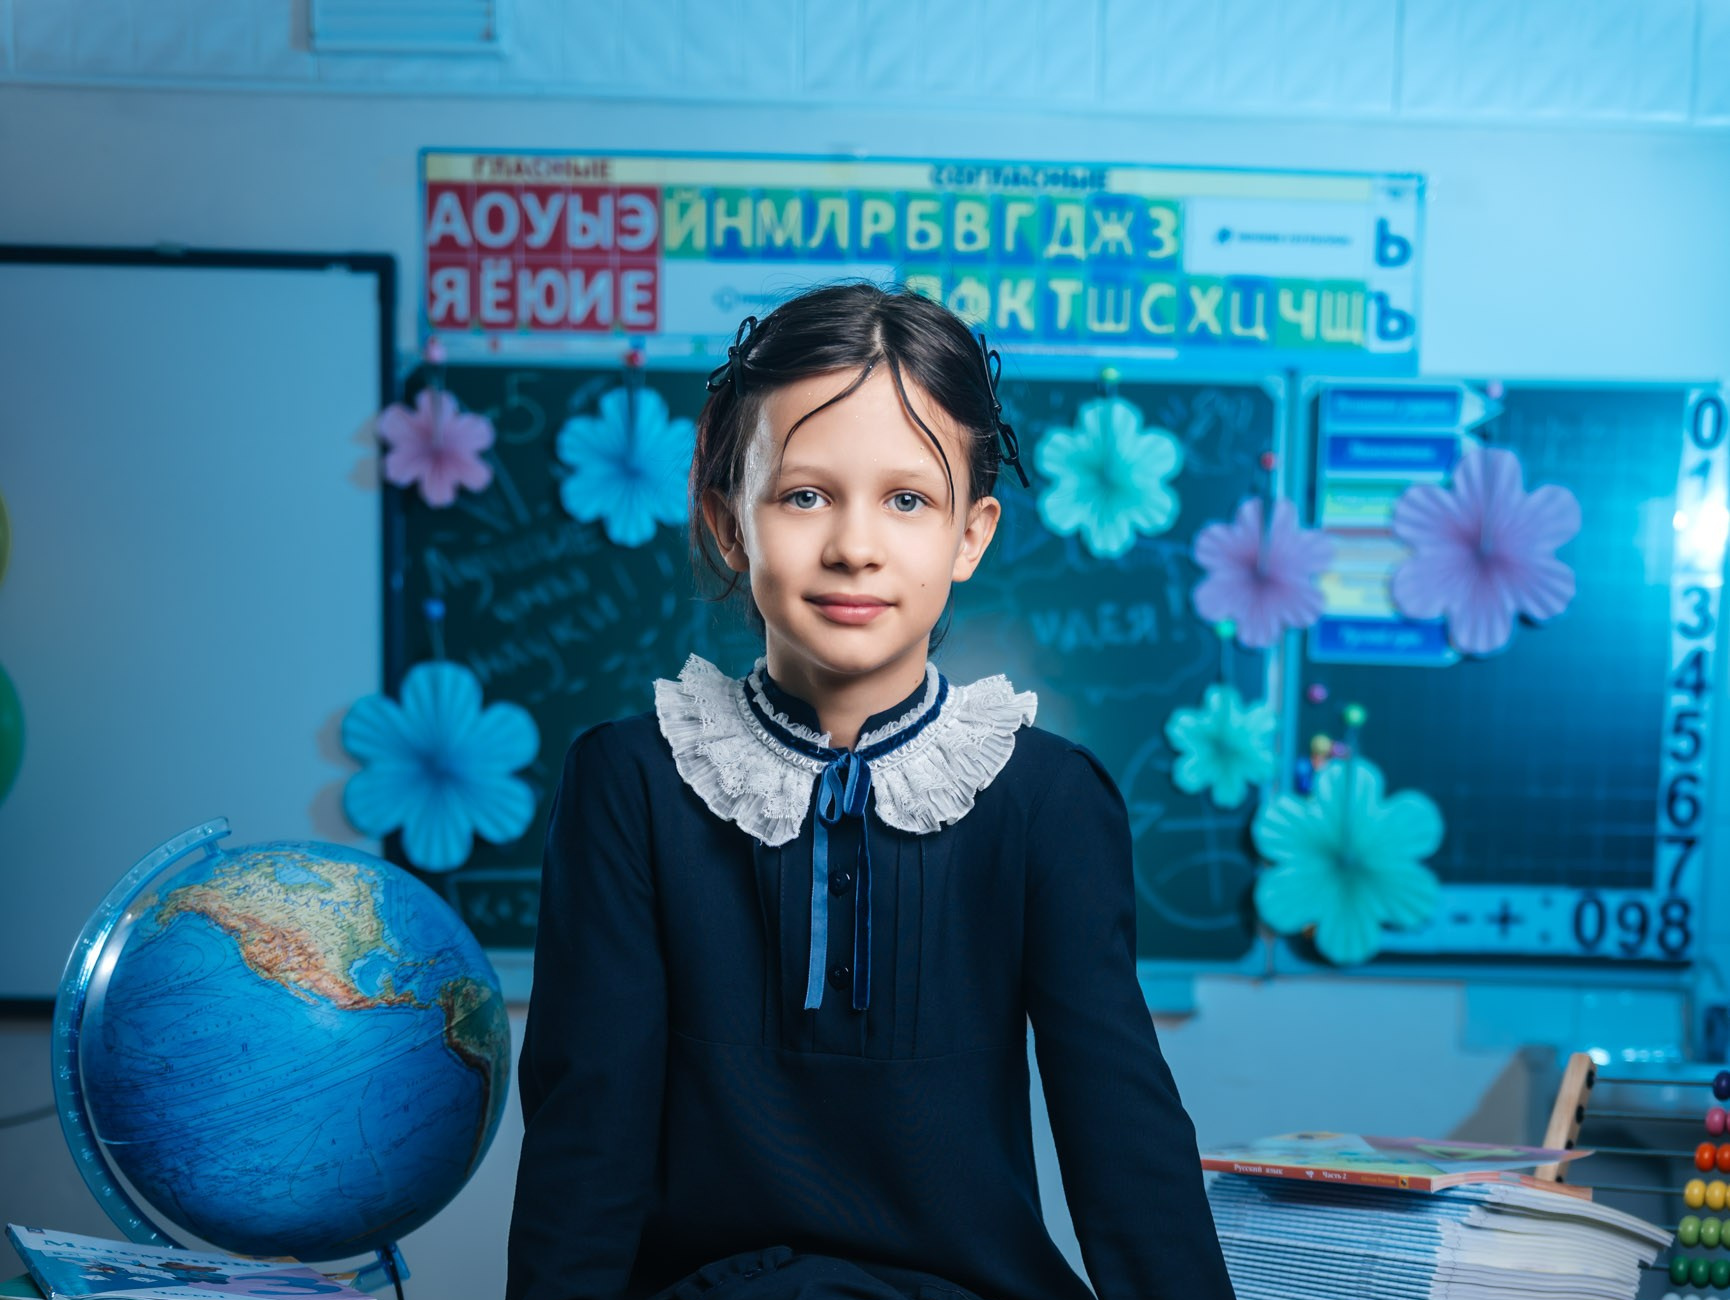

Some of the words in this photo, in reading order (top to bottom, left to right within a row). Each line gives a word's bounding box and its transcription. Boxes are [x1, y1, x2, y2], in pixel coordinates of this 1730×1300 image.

[471, 155, 613, 179] ГЛАСНЫЕ
[928, 165, 1109, 190] СОГЛАСНЫЕ
[1233, 1163, 1263, 1175] Русский
[1265, 1167, 1284, 1175] язык
[1322, 1170, 1342, 1180] Часть
[1342, 1172, 1348, 1180] 2
[44, 1238, 272, 1268] Математика
[233, 1274, 344, 1297] 3
